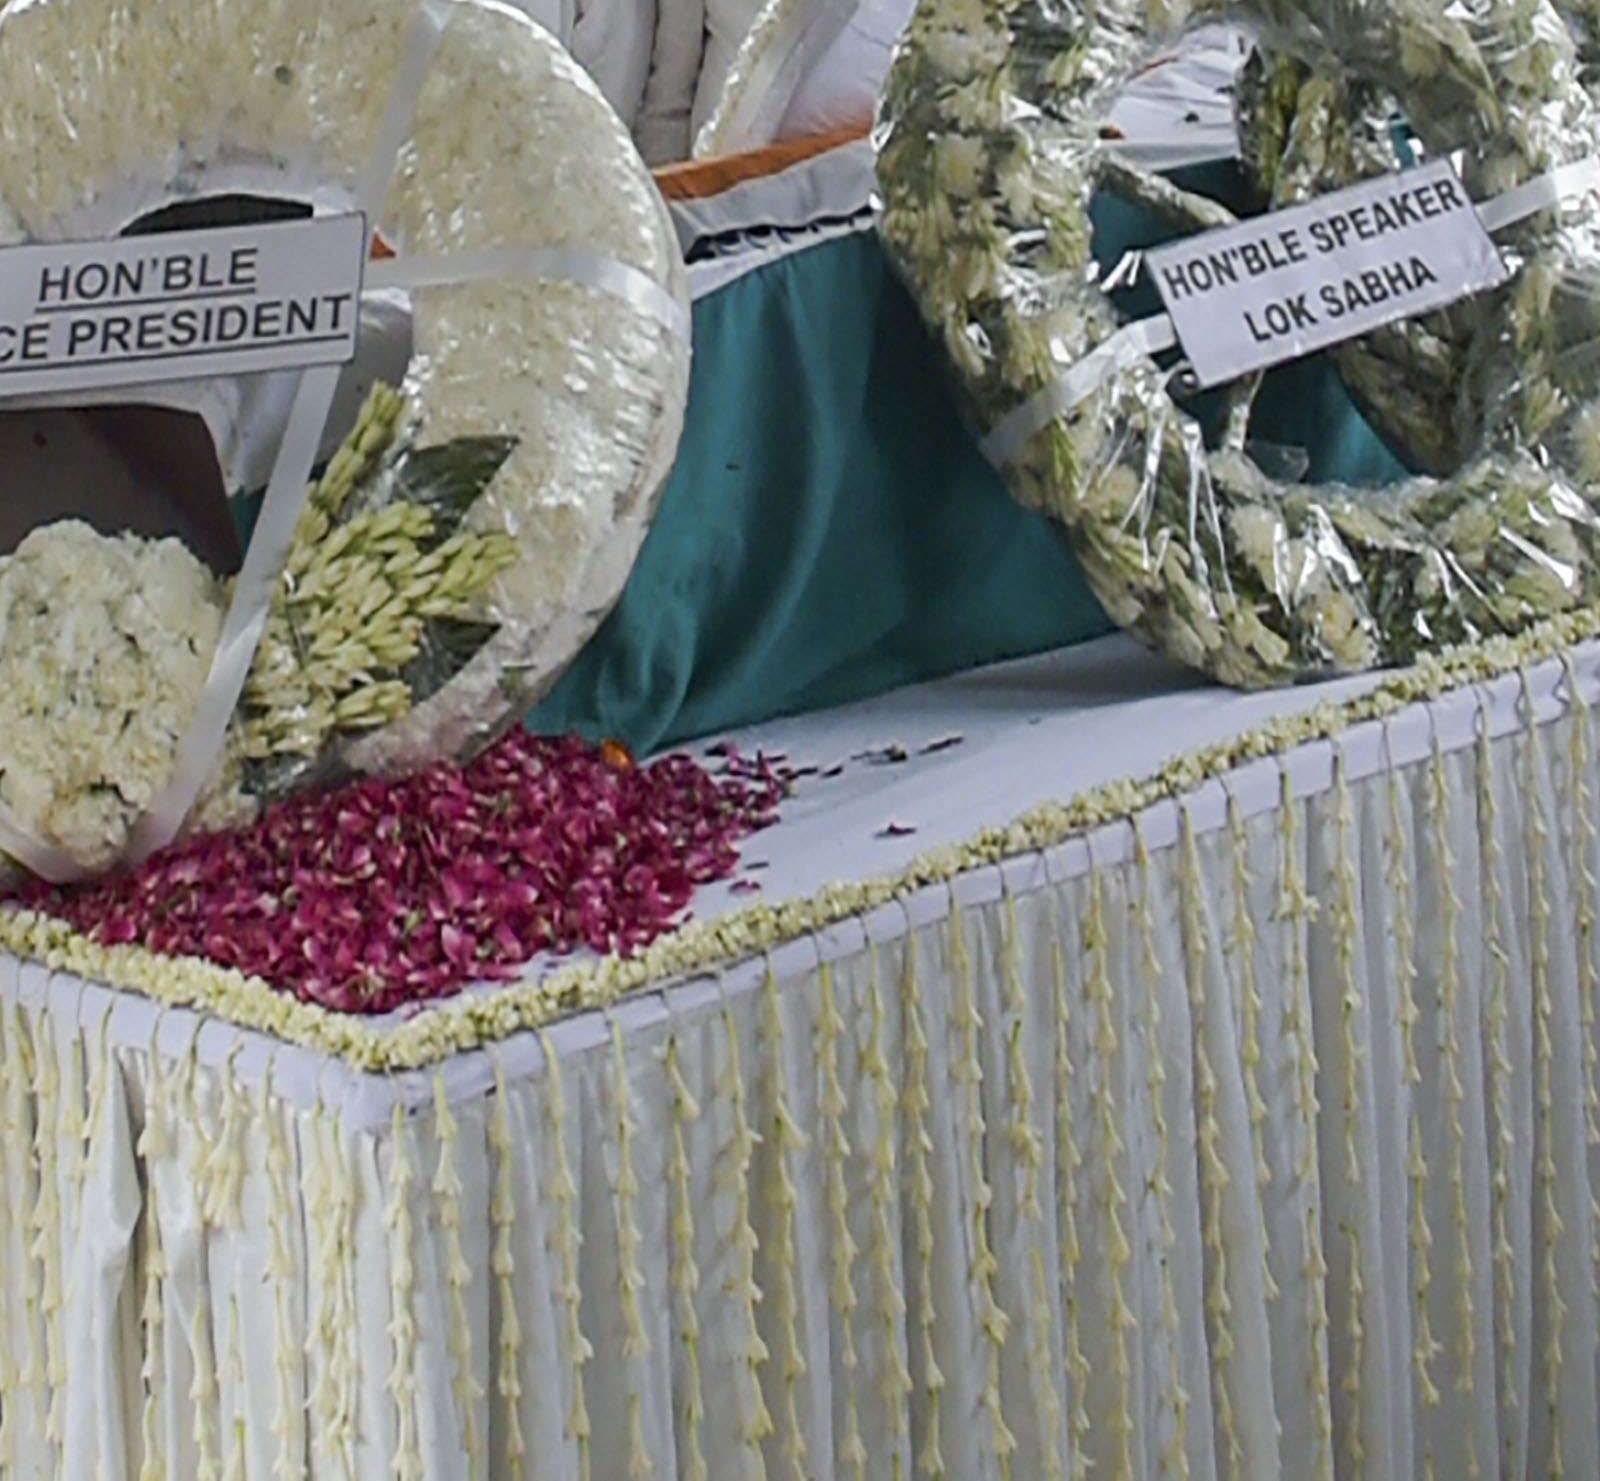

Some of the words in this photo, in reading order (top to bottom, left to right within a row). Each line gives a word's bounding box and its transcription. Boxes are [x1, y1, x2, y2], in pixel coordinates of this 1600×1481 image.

[38, 247, 259, 303] HON'BLE
[1163, 227, 1303, 301] HON'BLE
[1314, 178, 1465, 255] SPEAKER
[66, 292, 353, 357] PRESIDENT
[1243, 293, 1319, 344] LOK
[1322, 256, 1438, 318] SABHA
